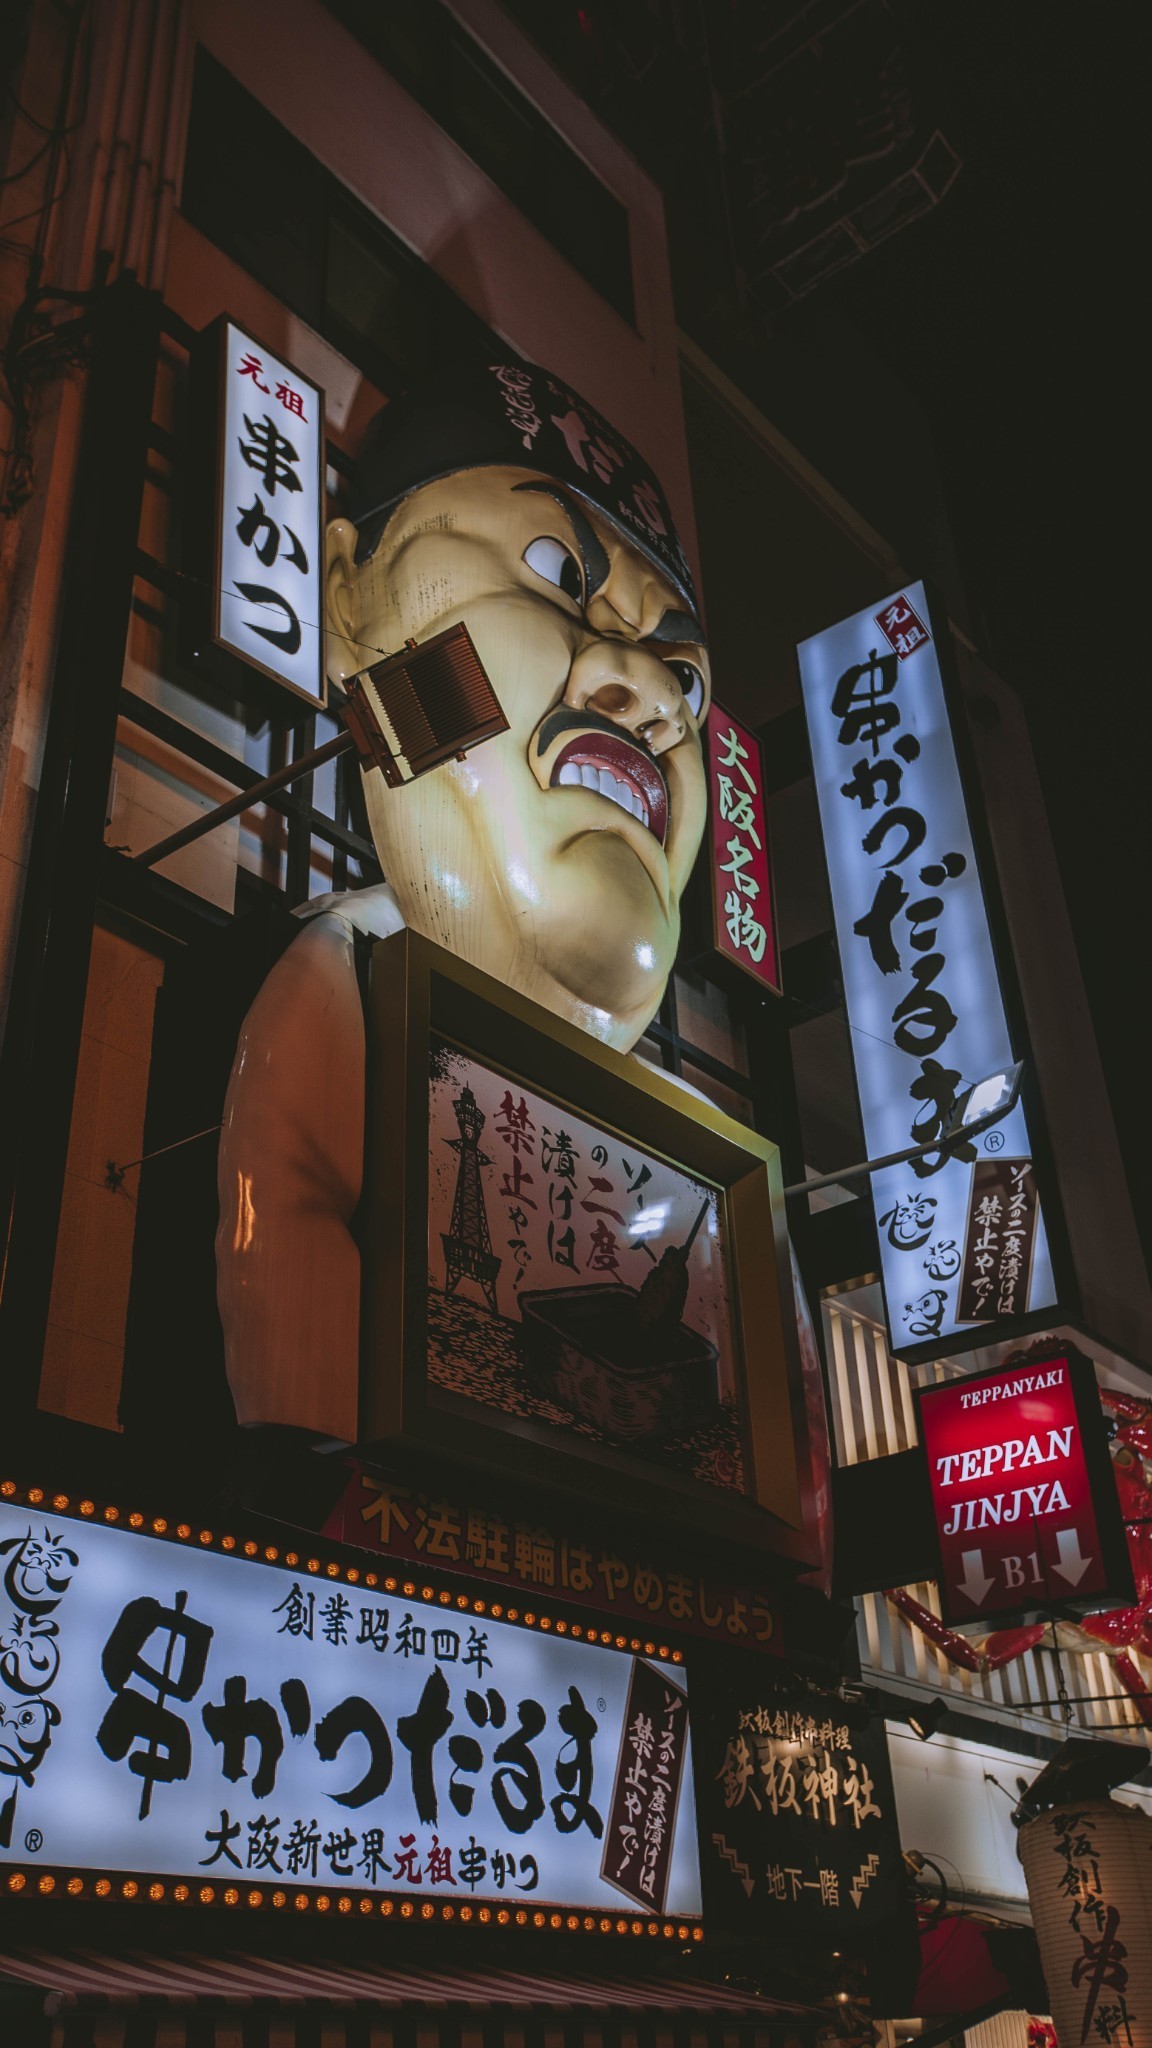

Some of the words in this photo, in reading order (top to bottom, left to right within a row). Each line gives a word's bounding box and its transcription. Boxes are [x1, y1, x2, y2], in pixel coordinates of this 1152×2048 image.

[236, 352, 308, 425] 元祖
[232, 414, 309, 655] 串かつ
[885, 603, 926, 655] 元祖
[717, 727, 767, 963] 大阪名物
[830, 648, 977, 1179] 串かつだるま
[541, 1125, 580, 1275] 漬けは
[997, 1162, 1032, 1314] ソースの二度漬けは
[970, 1195, 1003, 1316] 禁止やで!
[960, 1369, 1064, 1409] TEPPANYAKI
[936, 1426, 1074, 1487] TEPPAN
[943, 1480, 1071, 1536] JINJYA
[361, 1475, 774, 1642] 不法駐輪はやめましょう
[1001, 1551, 1044, 1589] B1
[272, 1582, 493, 1679] 創業昭和四年
[96, 1590, 604, 1840] 串かつだるま
[640, 1690, 683, 1898] ソースの二度漬けは
[714, 1733, 882, 1830] 鉄板神社
[198, 1809, 539, 1893] 大阪新世界元祖串かつ
[766, 1864, 840, 1907] 地下一階
